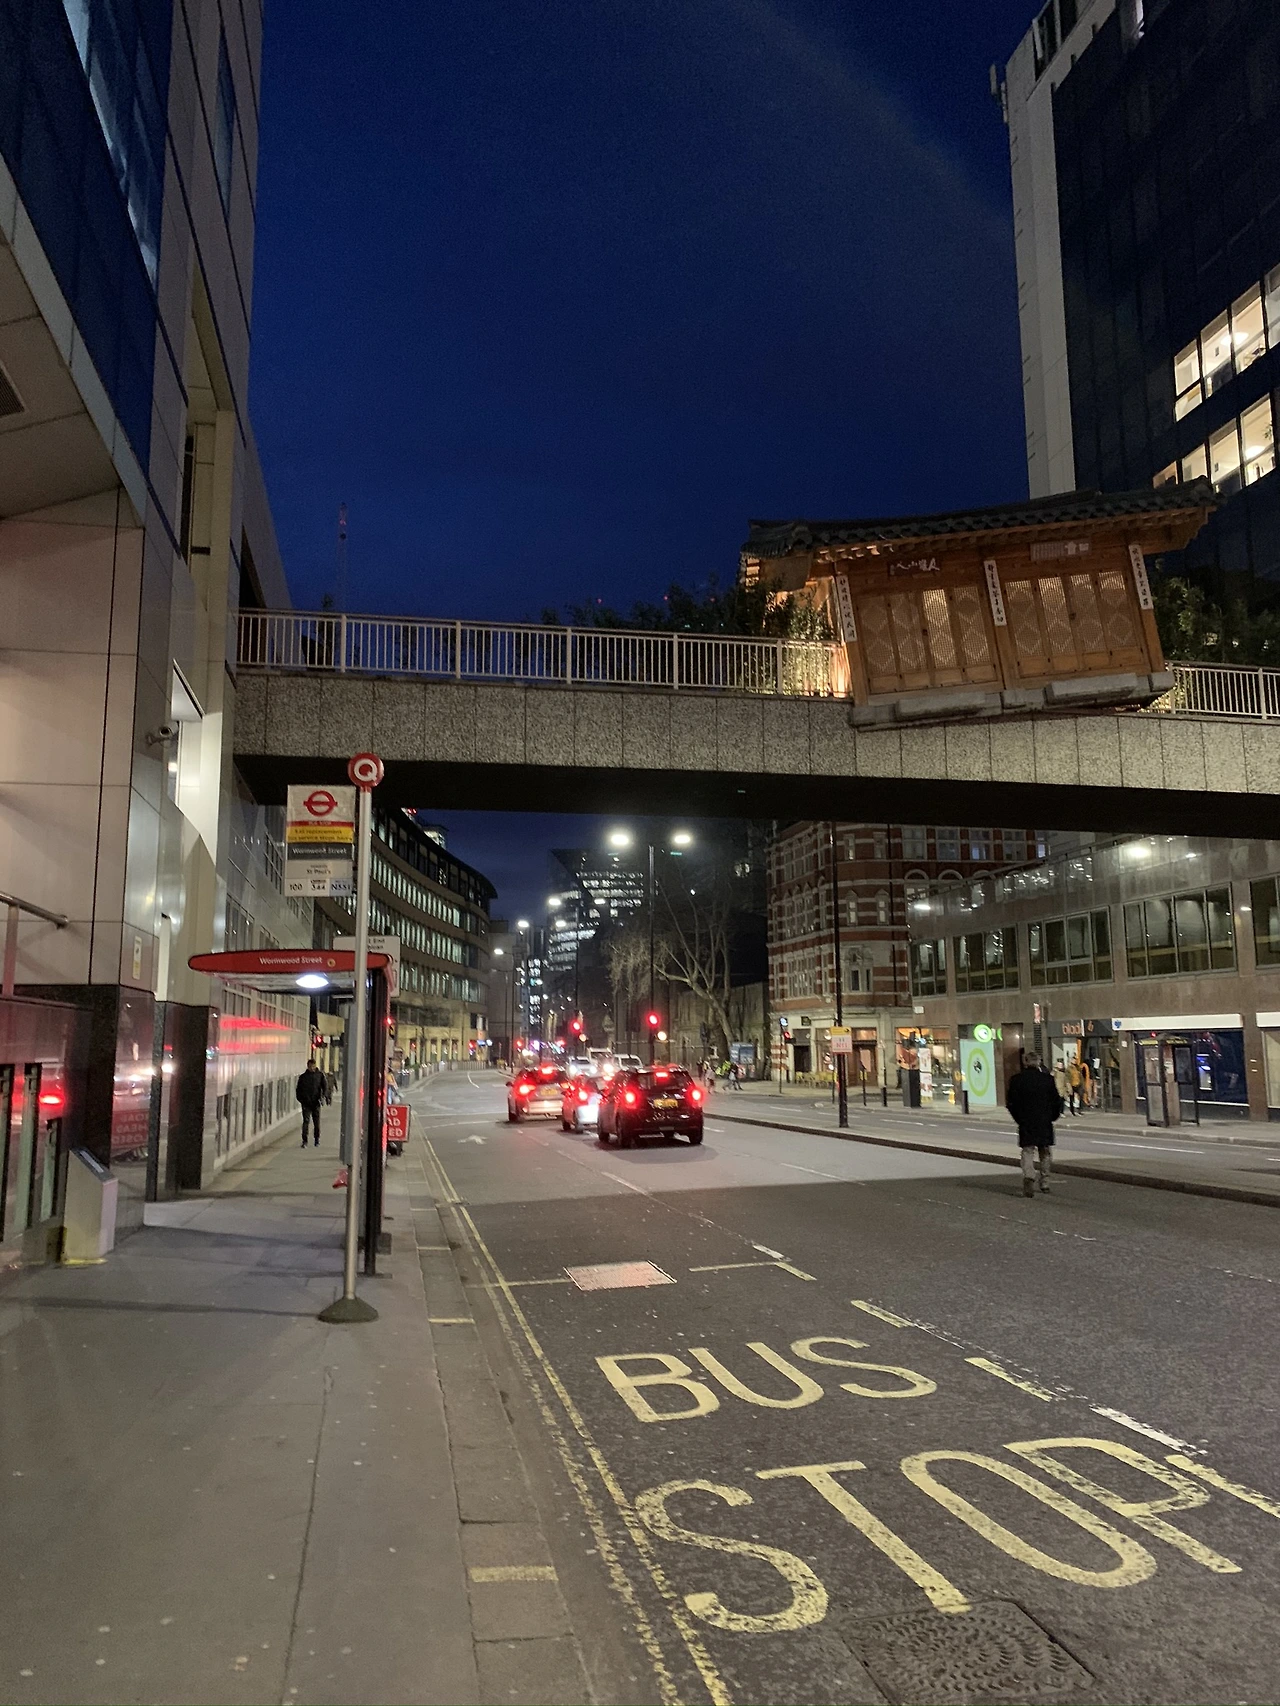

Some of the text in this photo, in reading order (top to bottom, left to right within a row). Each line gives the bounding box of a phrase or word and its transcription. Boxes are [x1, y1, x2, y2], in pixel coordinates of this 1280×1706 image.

[354, 759, 378, 781] Q
[292, 847, 347, 855] Wormwood Street
[289, 883, 303, 891] 100
[259, 956, 323, 965] Wormwood Street
[594, 1335, 938, 1424] BUS
[634, 1436, 1243, 1634] STOP
